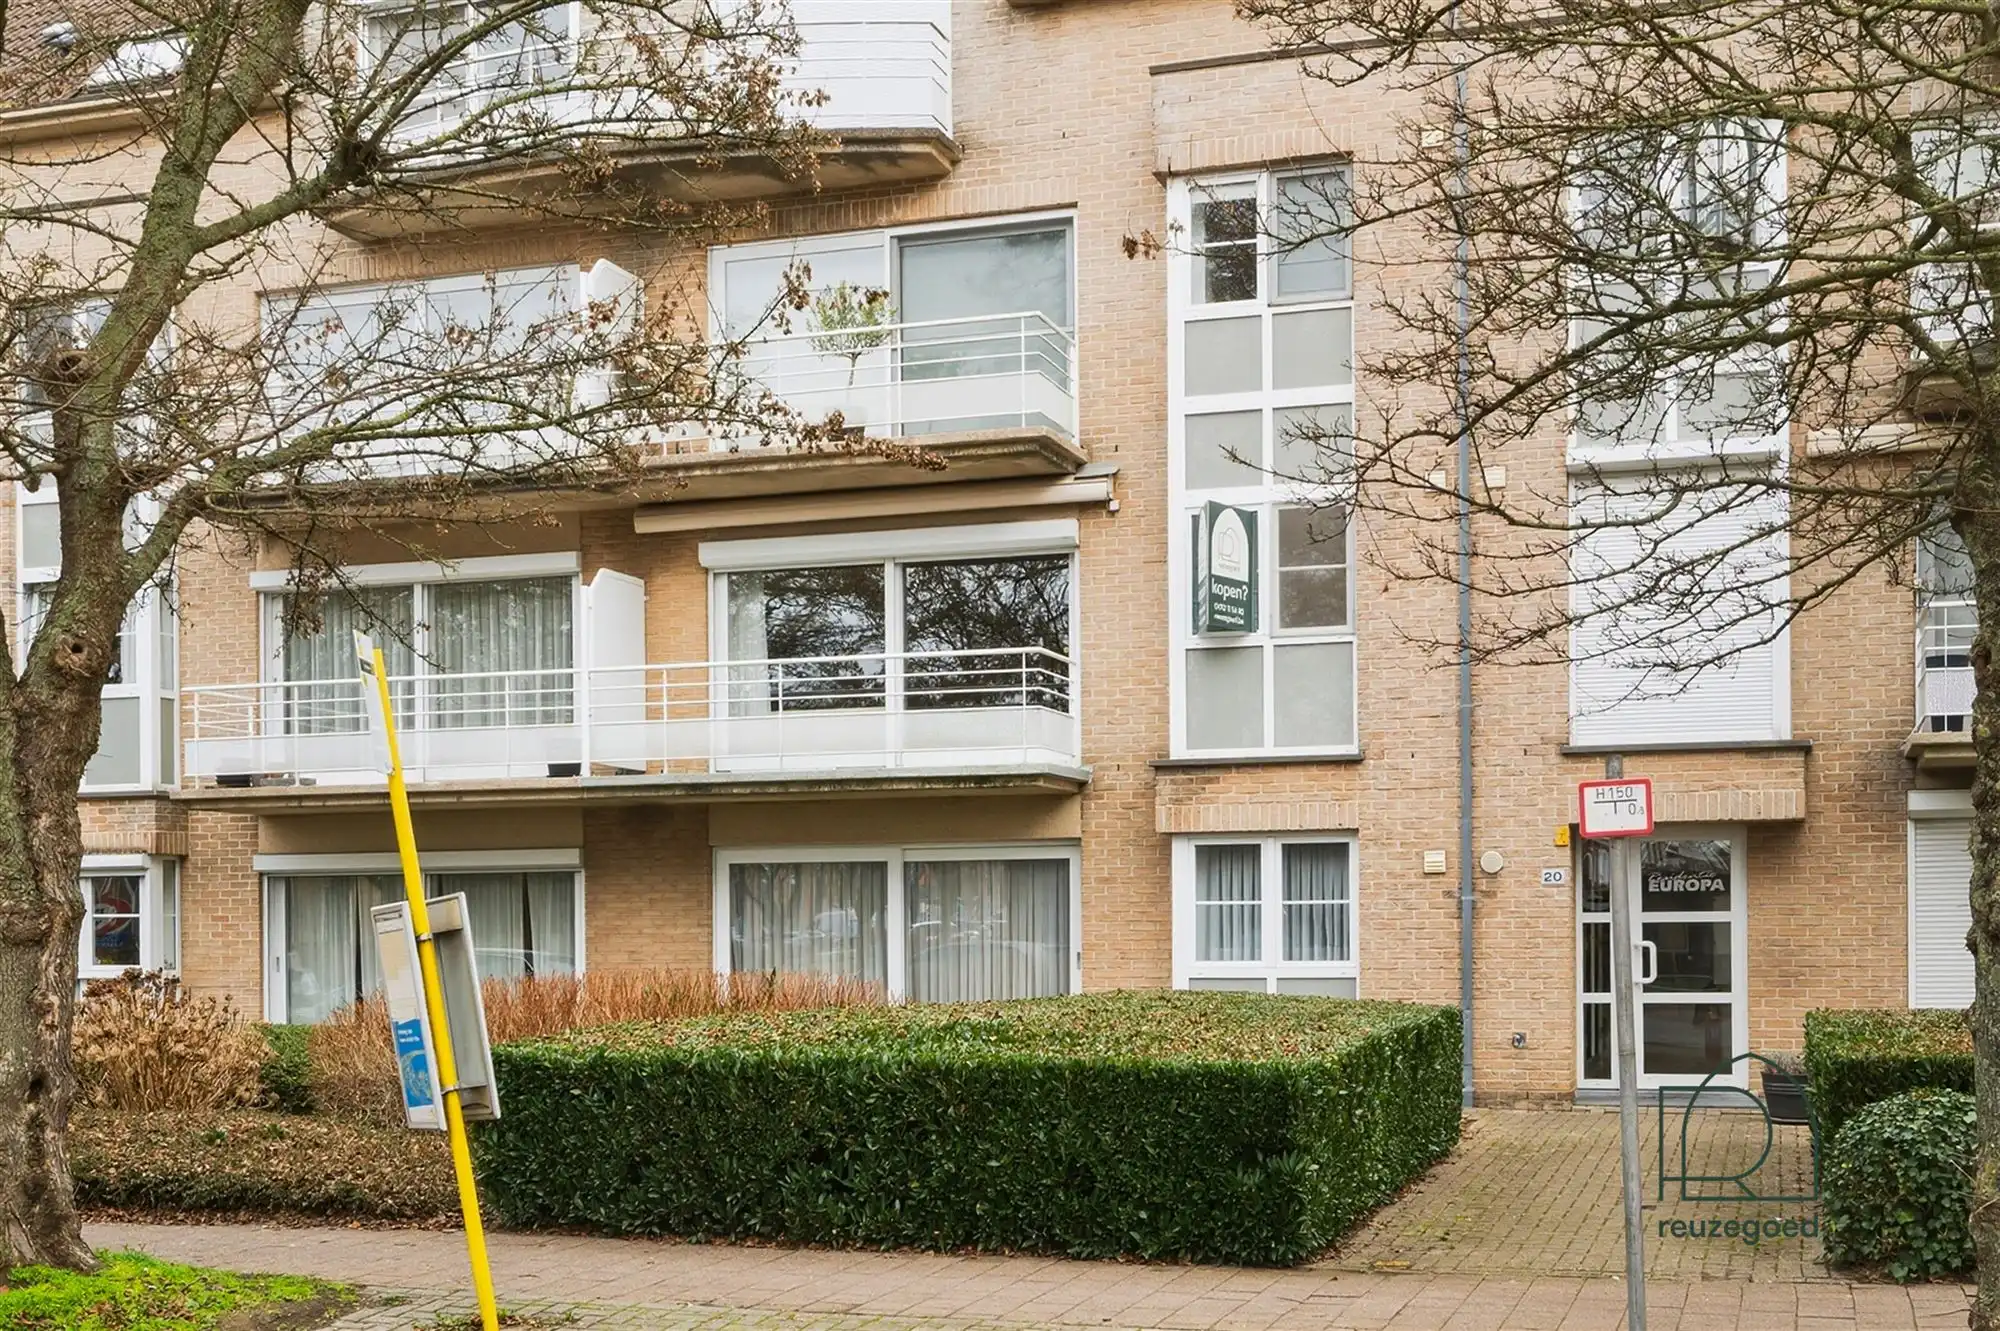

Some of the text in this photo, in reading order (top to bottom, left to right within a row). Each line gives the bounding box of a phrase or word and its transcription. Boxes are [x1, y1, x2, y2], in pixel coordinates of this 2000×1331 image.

[1211, 577, 1248, 601] kopen?
[1543, 871, 1563, 882] 20
[1648, 878, 1726, 892] EUROPA
